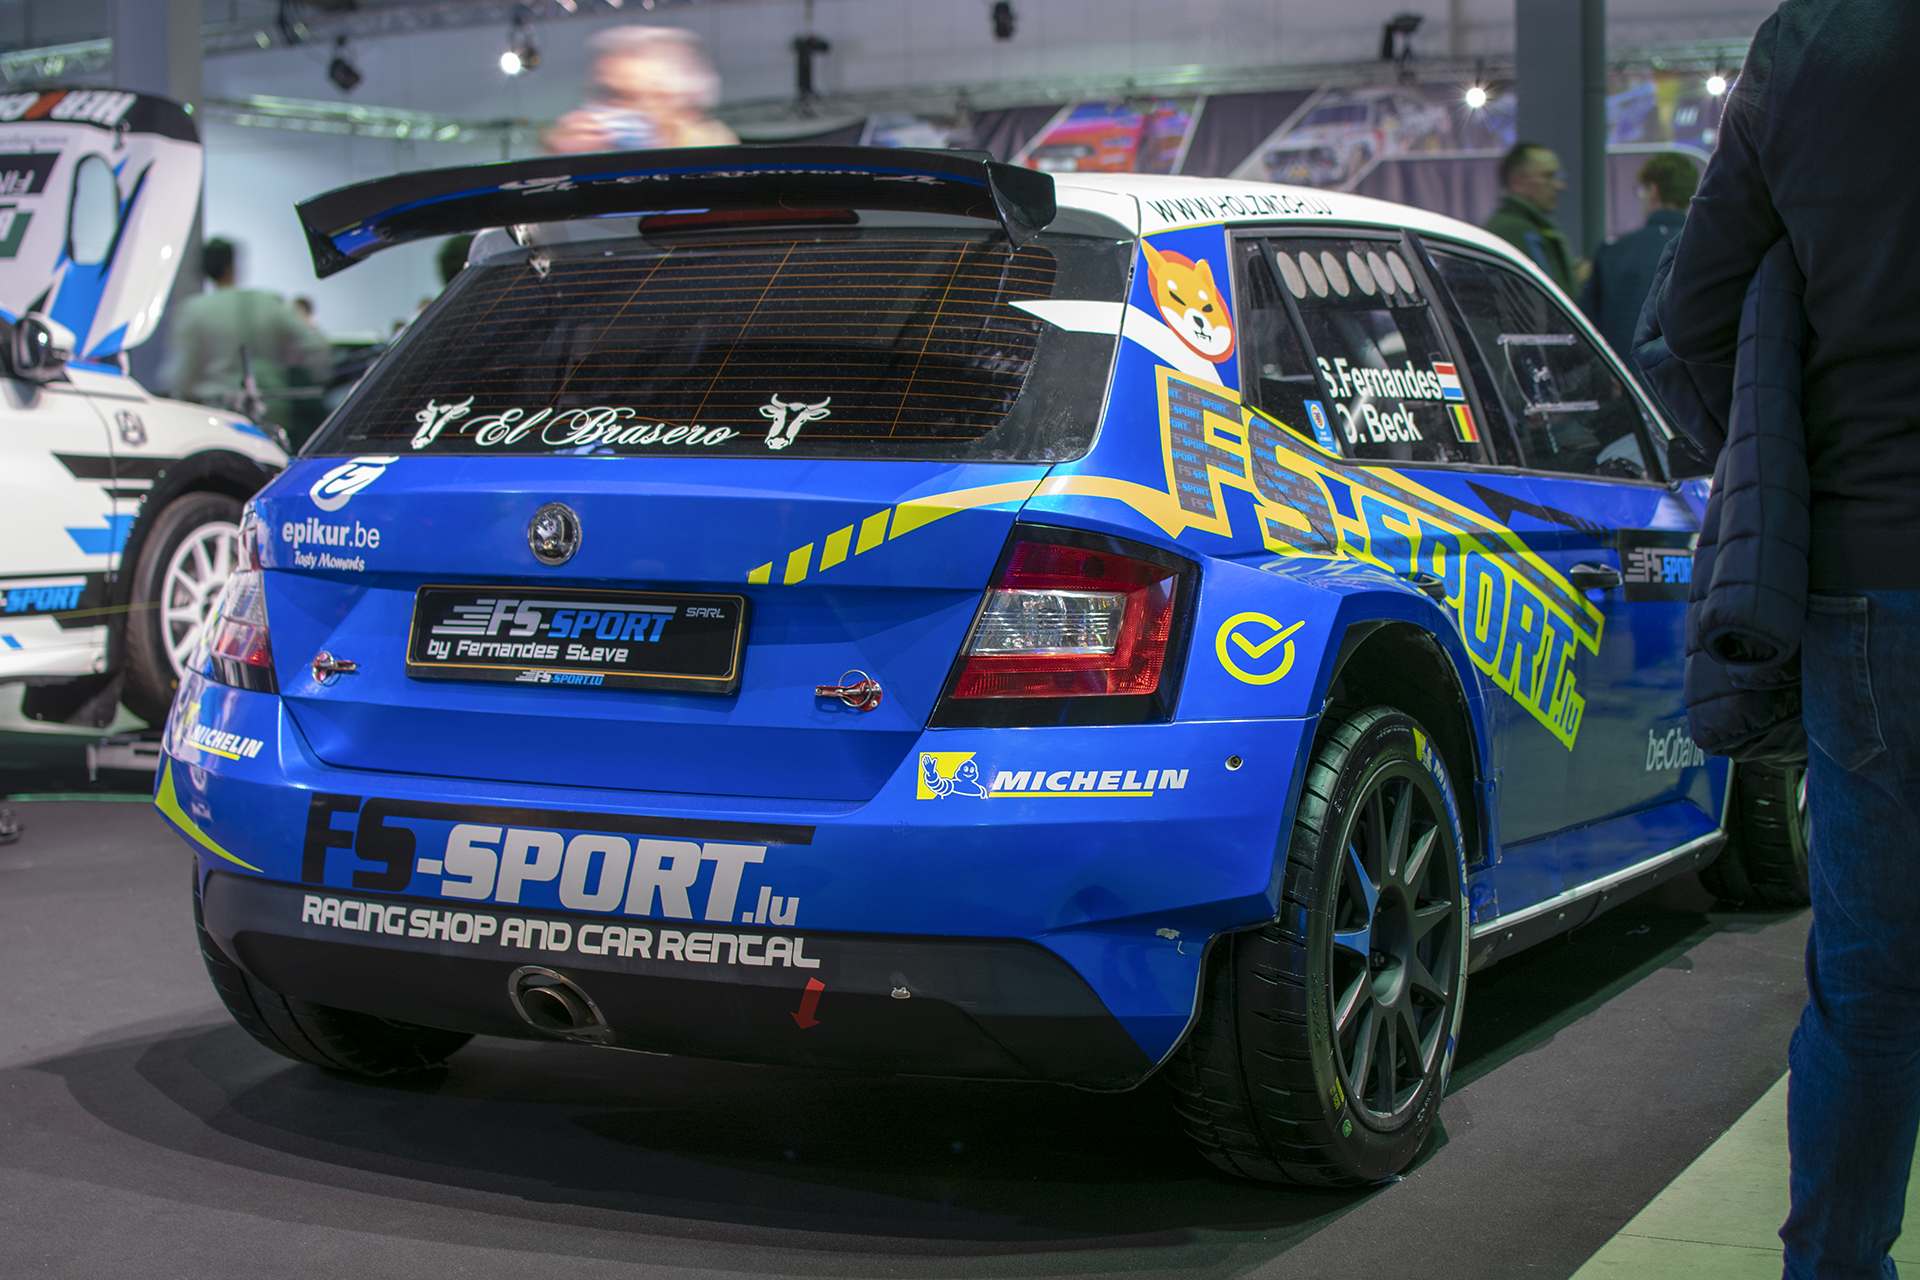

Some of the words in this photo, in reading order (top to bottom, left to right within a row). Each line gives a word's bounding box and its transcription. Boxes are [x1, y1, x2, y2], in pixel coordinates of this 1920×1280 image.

[1316, 356, 1443, 400] S.Fernandes
[460, 407, 553, 446] El
[541, 406, 740, 446] Brasero
[1361, 402, 1424, 443] Beck
[282, 517, 380, 549] epikur.be
[294, 550, 318, 570] Tasty
[317, 552, 365, 573] Moments
[1643, 547, 1694, 584] FS-SPOR
[486, 599, 677, 643] FS-SPORT
[685, 607, 725, 619] SARL
[427, 639, 451, 660] by
[456, 640, 559, 660] Fernandes
[565, 644, 629, 663] Steve
[190, 724, 264, 759] MICHELIN
[988, 769, 1189, 791] MICHELIN
[300, 791, 800, 927] FS-SPORT.lu
[302, 895, 406, 936] RACING
[408, 909, 497, 945] SHOP
[500, 918, 572, 952] AND
[577, 925, 653, 959] CAR
[657, 930, 821, 969] RENTAL
